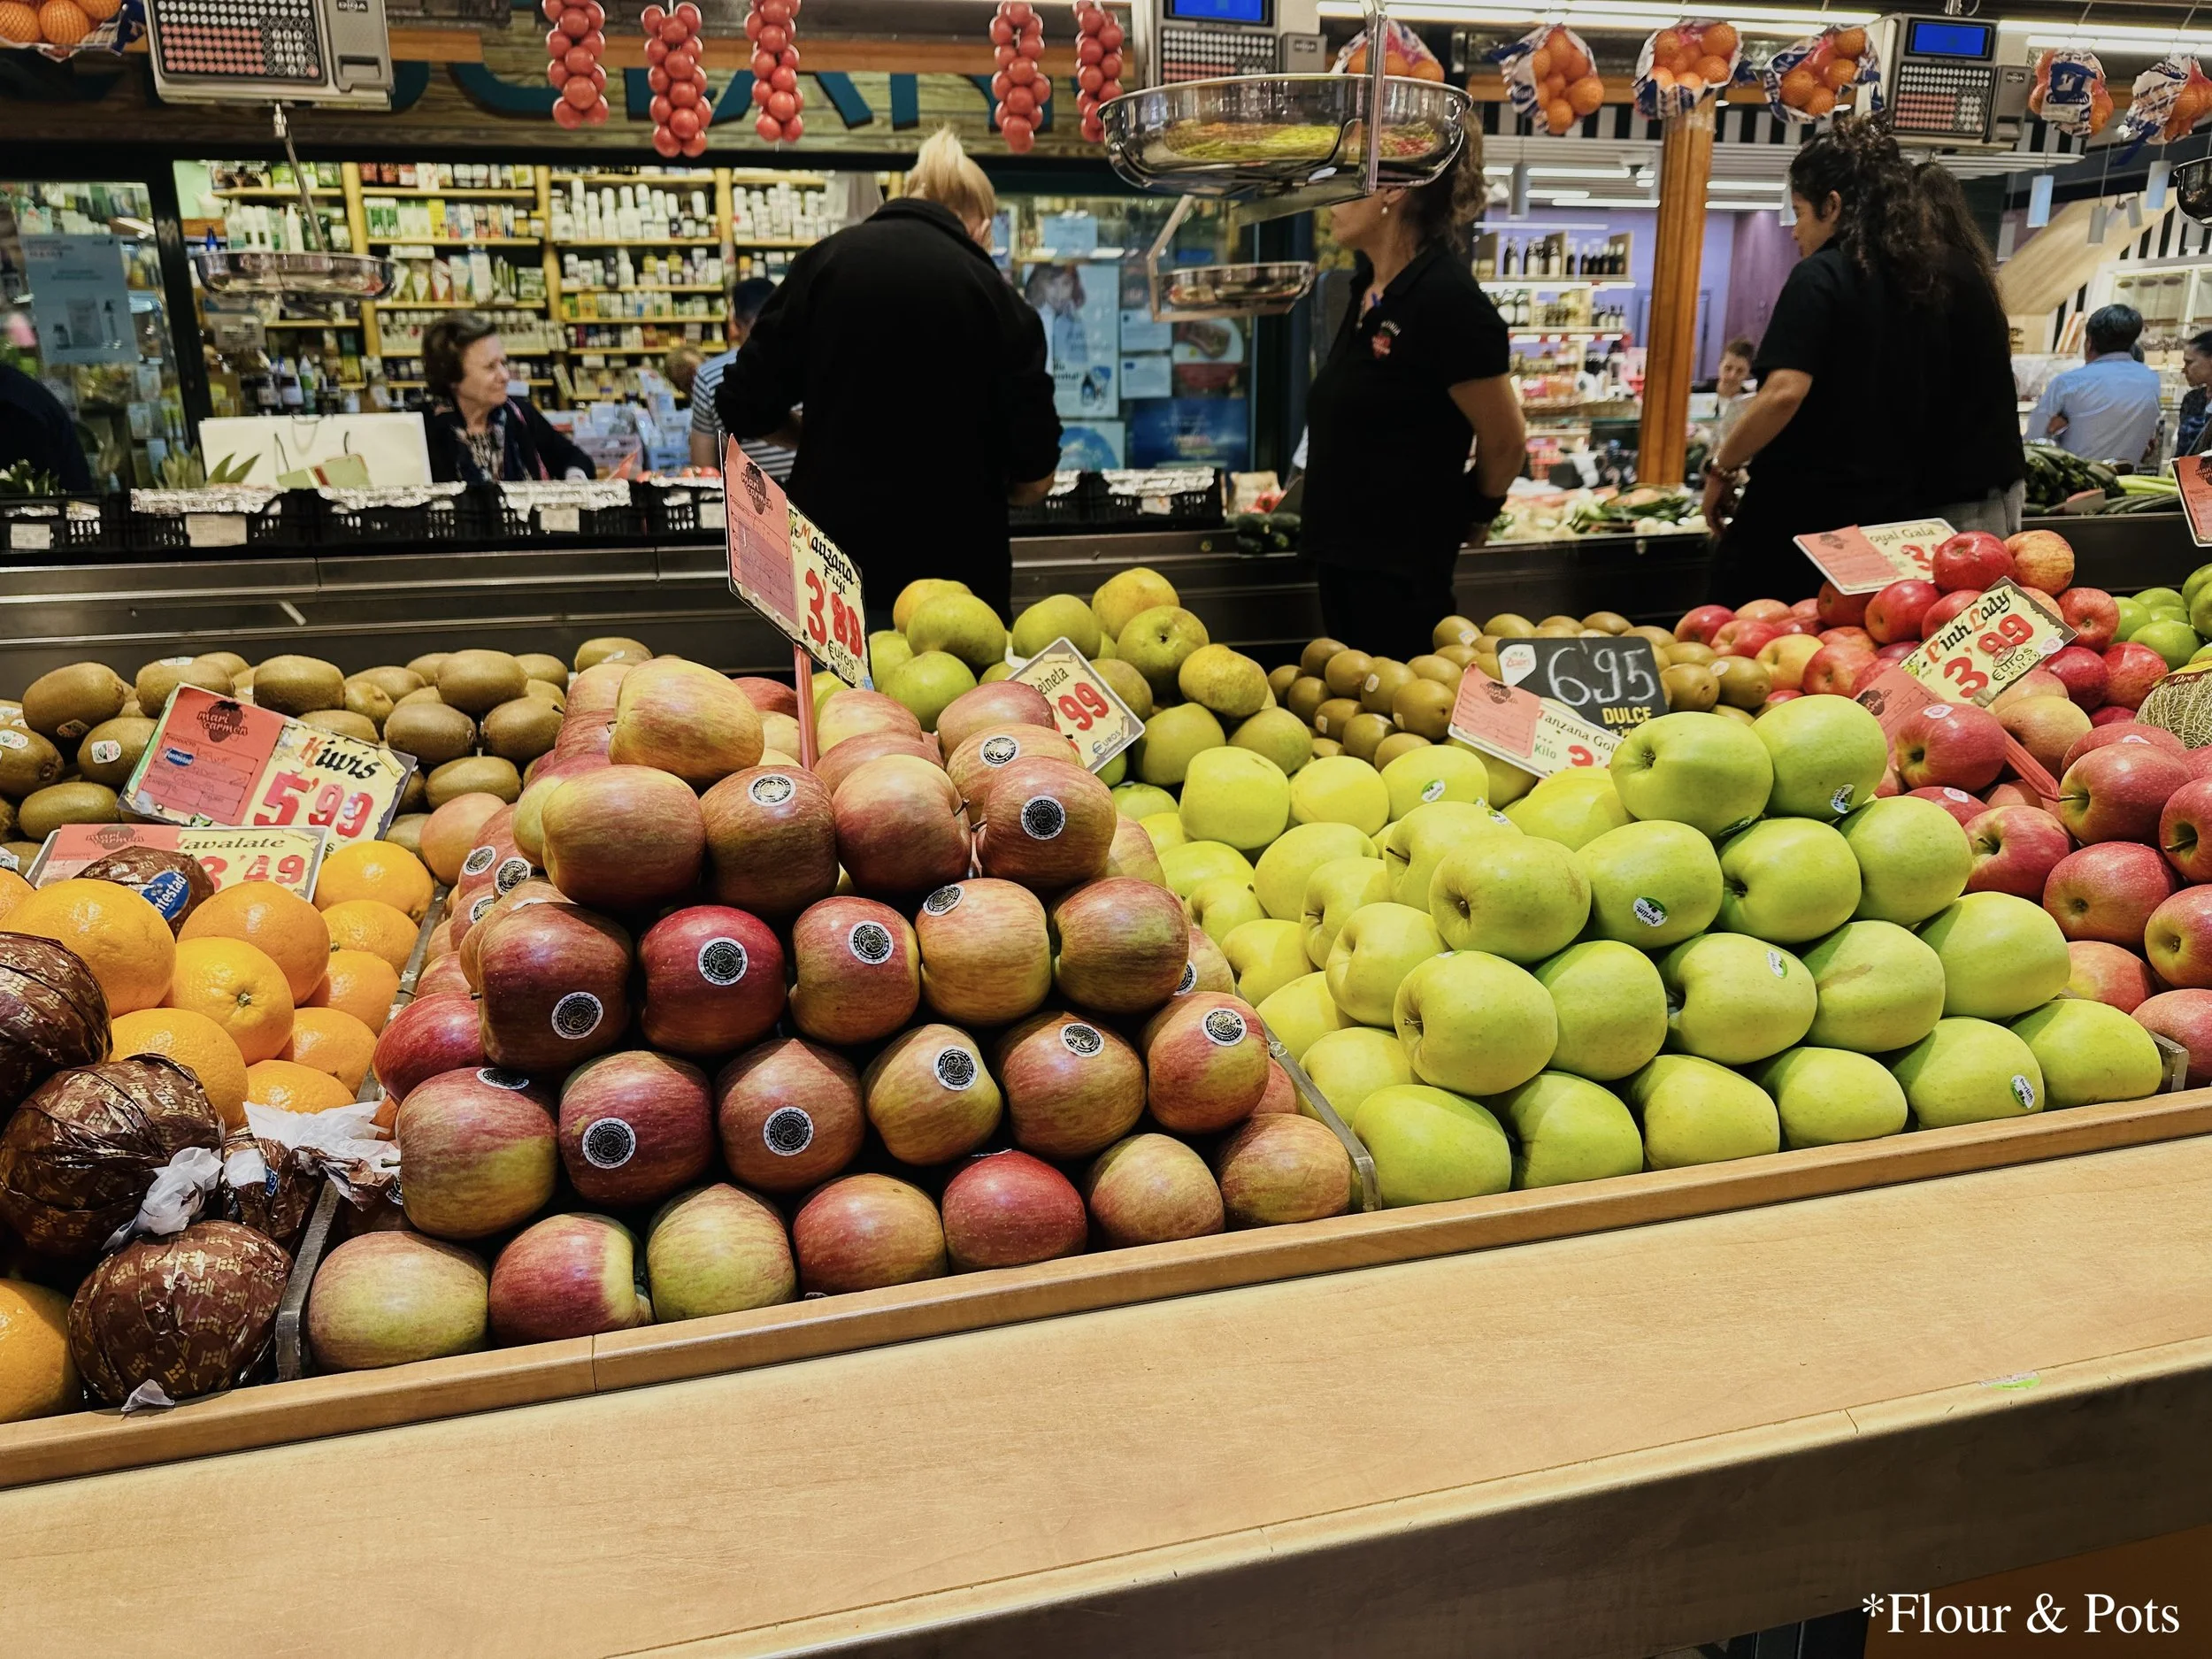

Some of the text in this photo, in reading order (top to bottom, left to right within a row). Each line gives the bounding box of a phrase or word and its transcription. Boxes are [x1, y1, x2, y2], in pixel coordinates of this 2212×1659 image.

[1870, 526, 1936, 546] oyal Gala
[799, 523, 855, 585] Manzana
[824, 564, 847, 595] Fuji
[1925, 619, 1972, 664] Pink
[1970, 588, 2010, 633] Lady
[197, 710, 229, 724] mari
[203, 719, 248, 736] carmen
[1602, 707, 1651, 724] DULCE
[1594, 734, 1616, 753] Gol
[299, 737, 381, 779] Kiwis
[154, 872, 188, 913] ntestad
